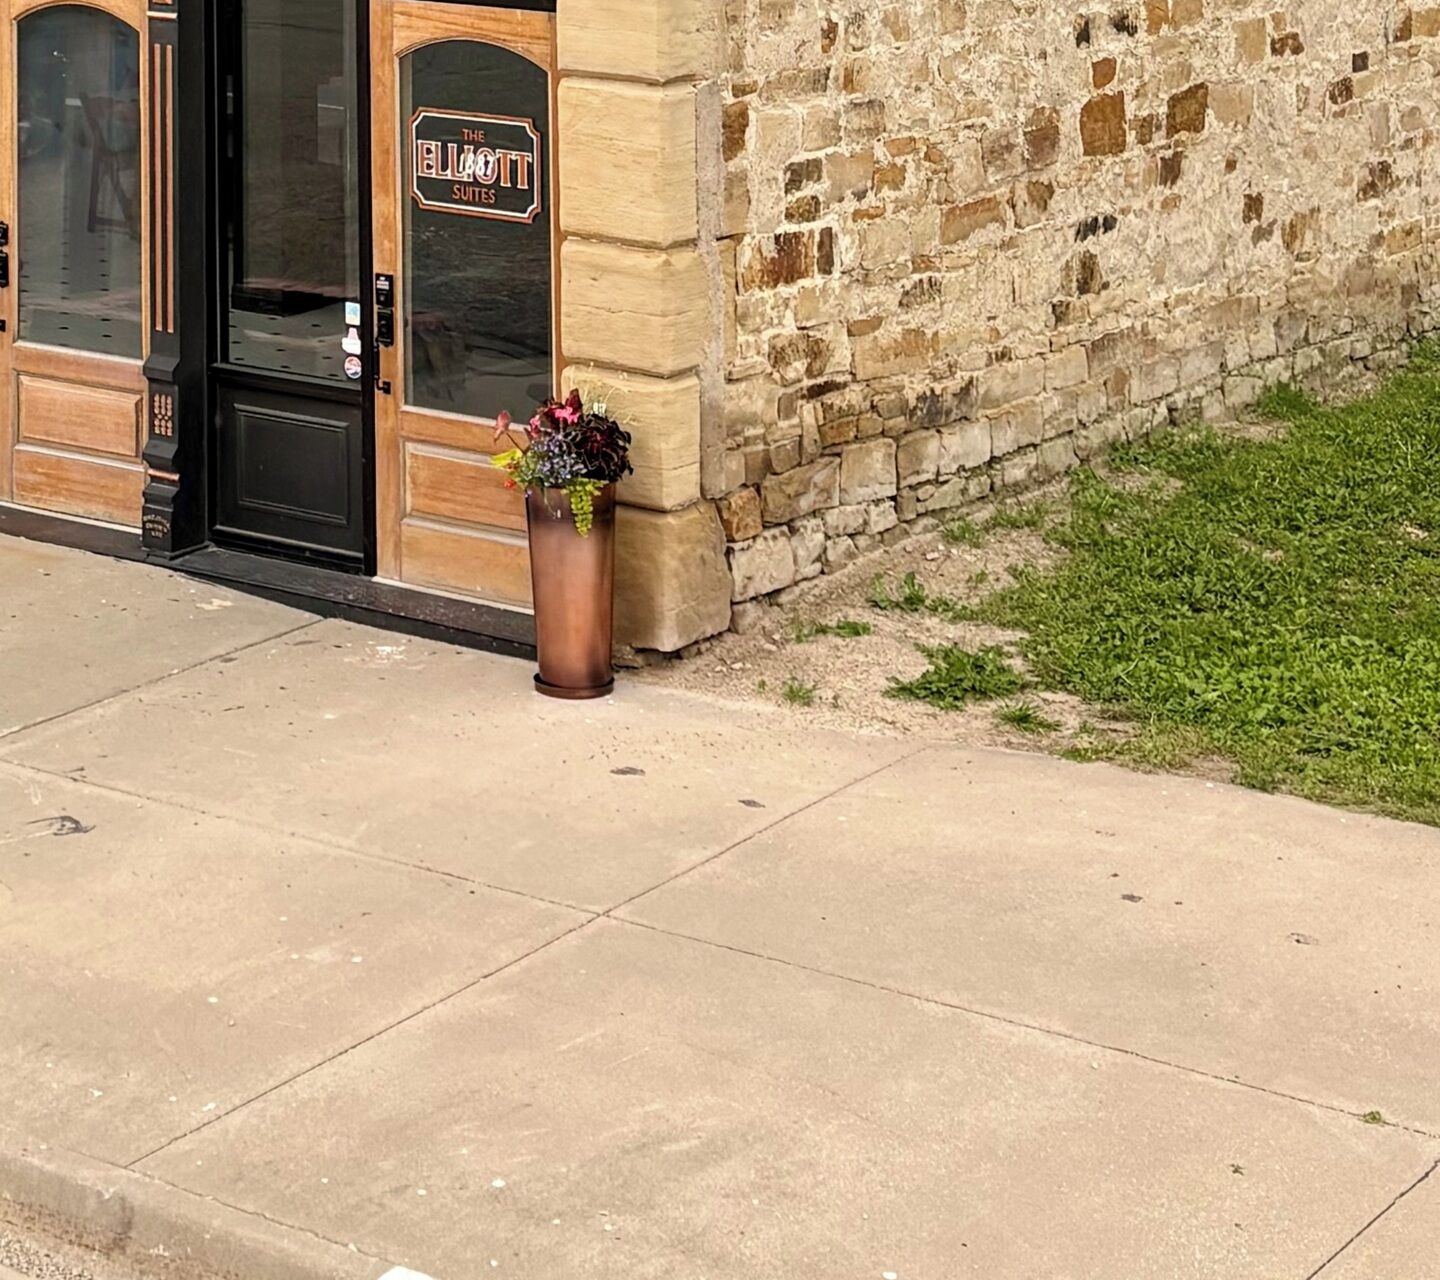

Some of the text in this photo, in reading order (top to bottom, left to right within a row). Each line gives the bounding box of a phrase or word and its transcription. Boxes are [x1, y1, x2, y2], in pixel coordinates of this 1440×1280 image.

[462, 128, 485, 142] THE
[417, 139, 533, 190] ELLIOTT
[459, 153, 496, 178] 1887
[452, 184, 496, 204] SUITES
